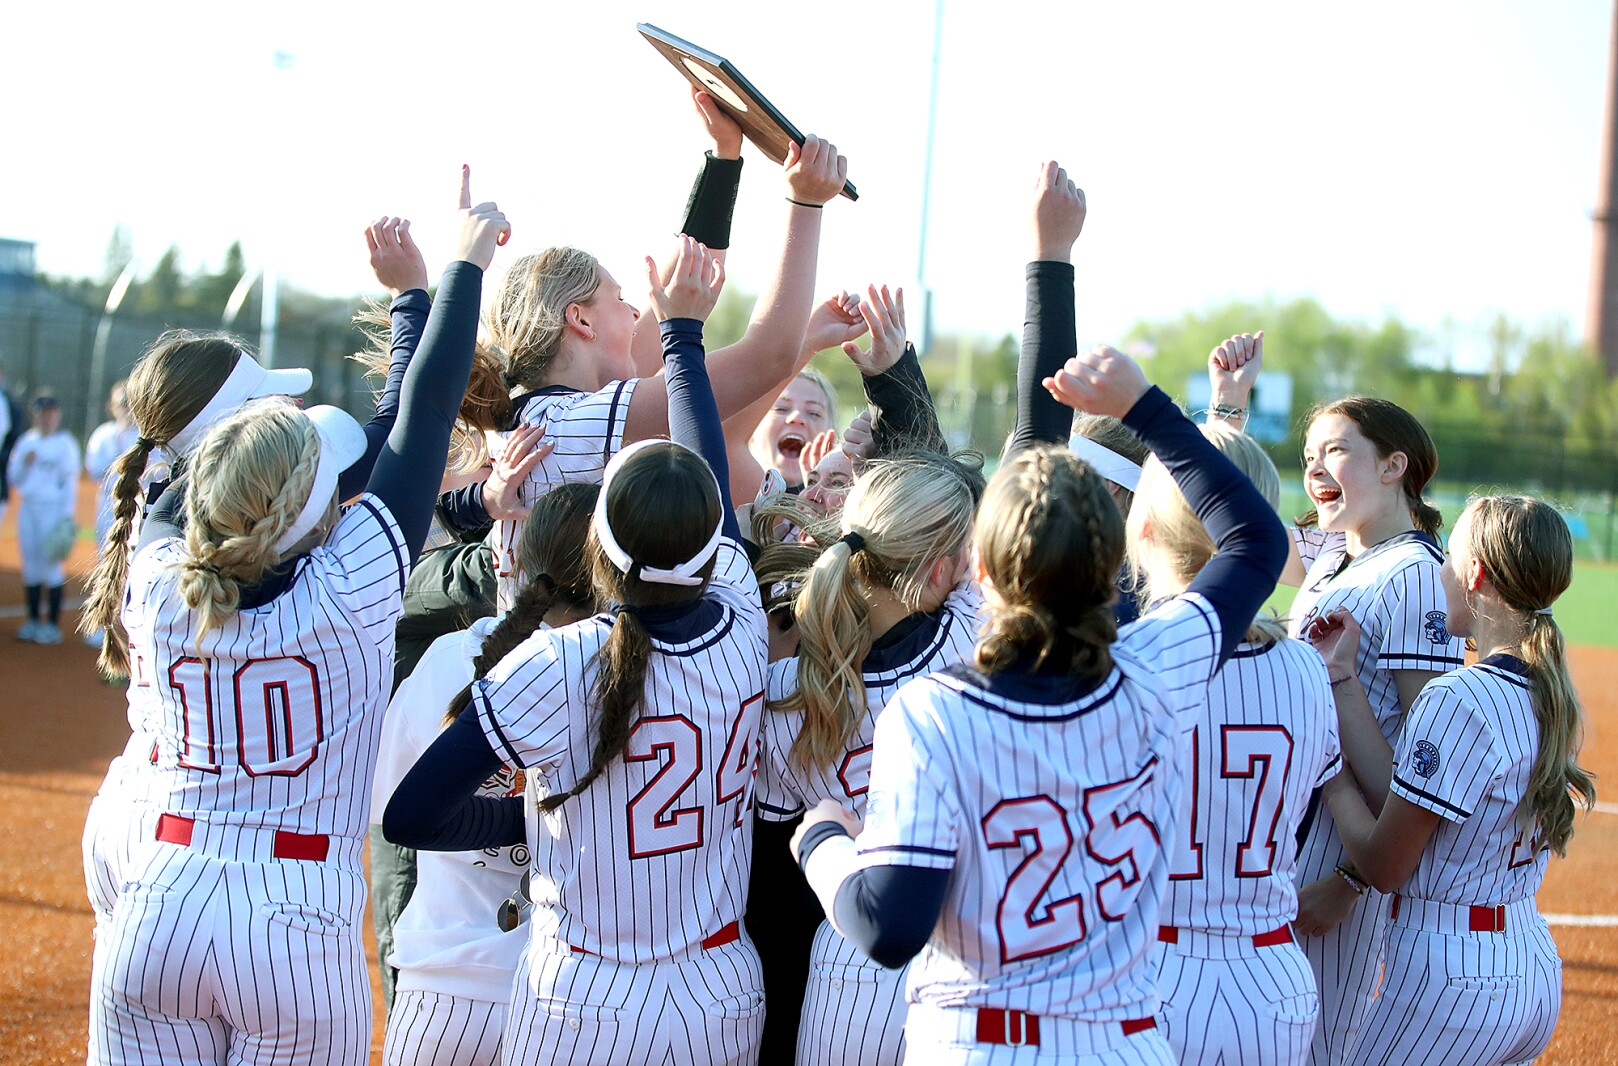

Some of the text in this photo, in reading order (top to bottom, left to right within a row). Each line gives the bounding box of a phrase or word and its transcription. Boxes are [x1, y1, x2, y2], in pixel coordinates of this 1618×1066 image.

[168, 655, 325, 777] 10
[623, 689, 761, 860] 24
[981, 748, 1161, 965] 25
[1168, 724, 1294, 880] 17
